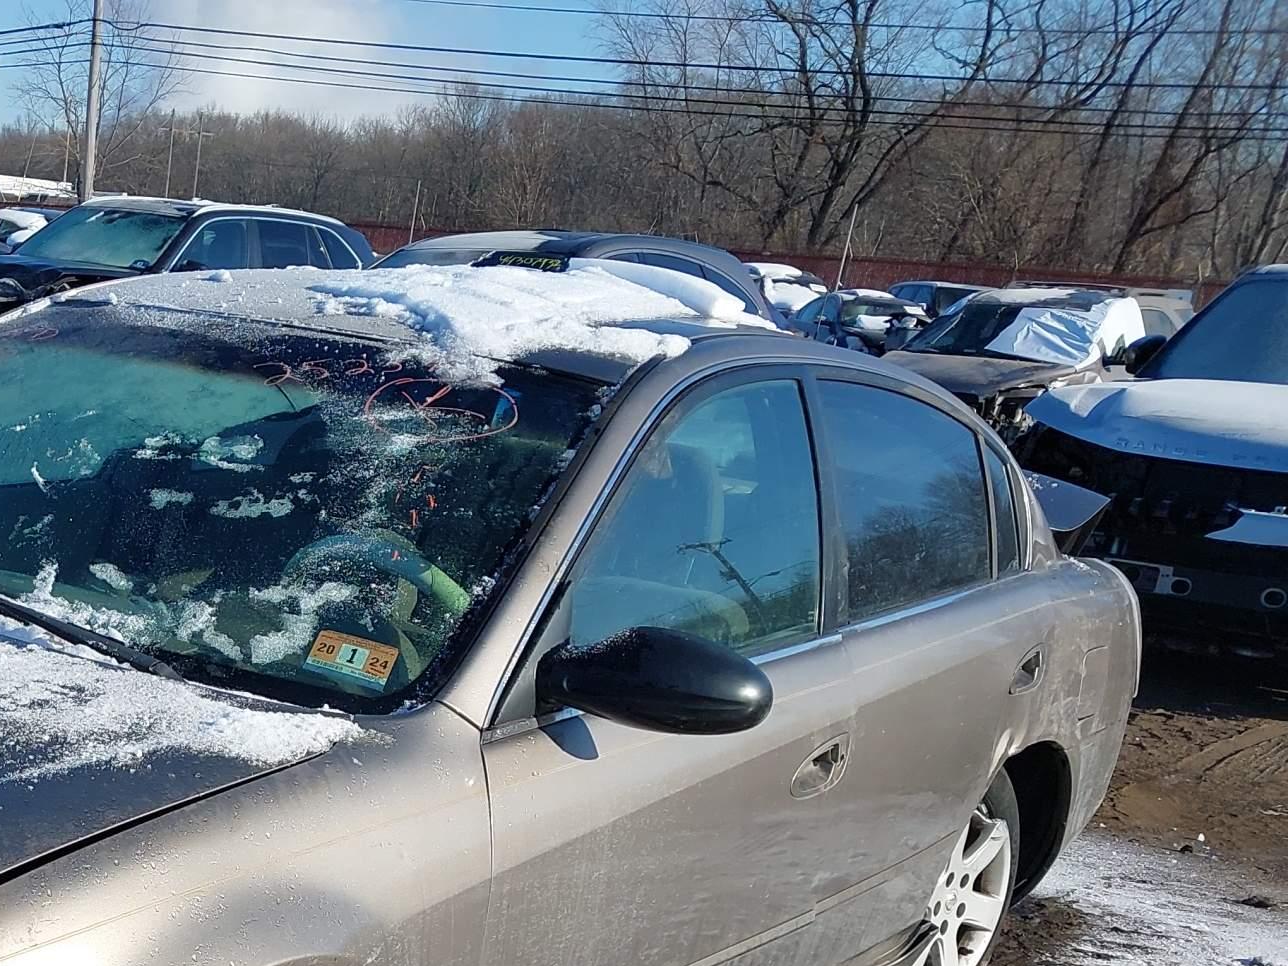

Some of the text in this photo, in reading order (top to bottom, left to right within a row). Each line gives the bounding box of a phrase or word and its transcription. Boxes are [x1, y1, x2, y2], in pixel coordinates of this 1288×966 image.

[316, 642, 336, 655] 20
[345, 648, 359, 664] 1
[369, 656, 389, 670] 24
